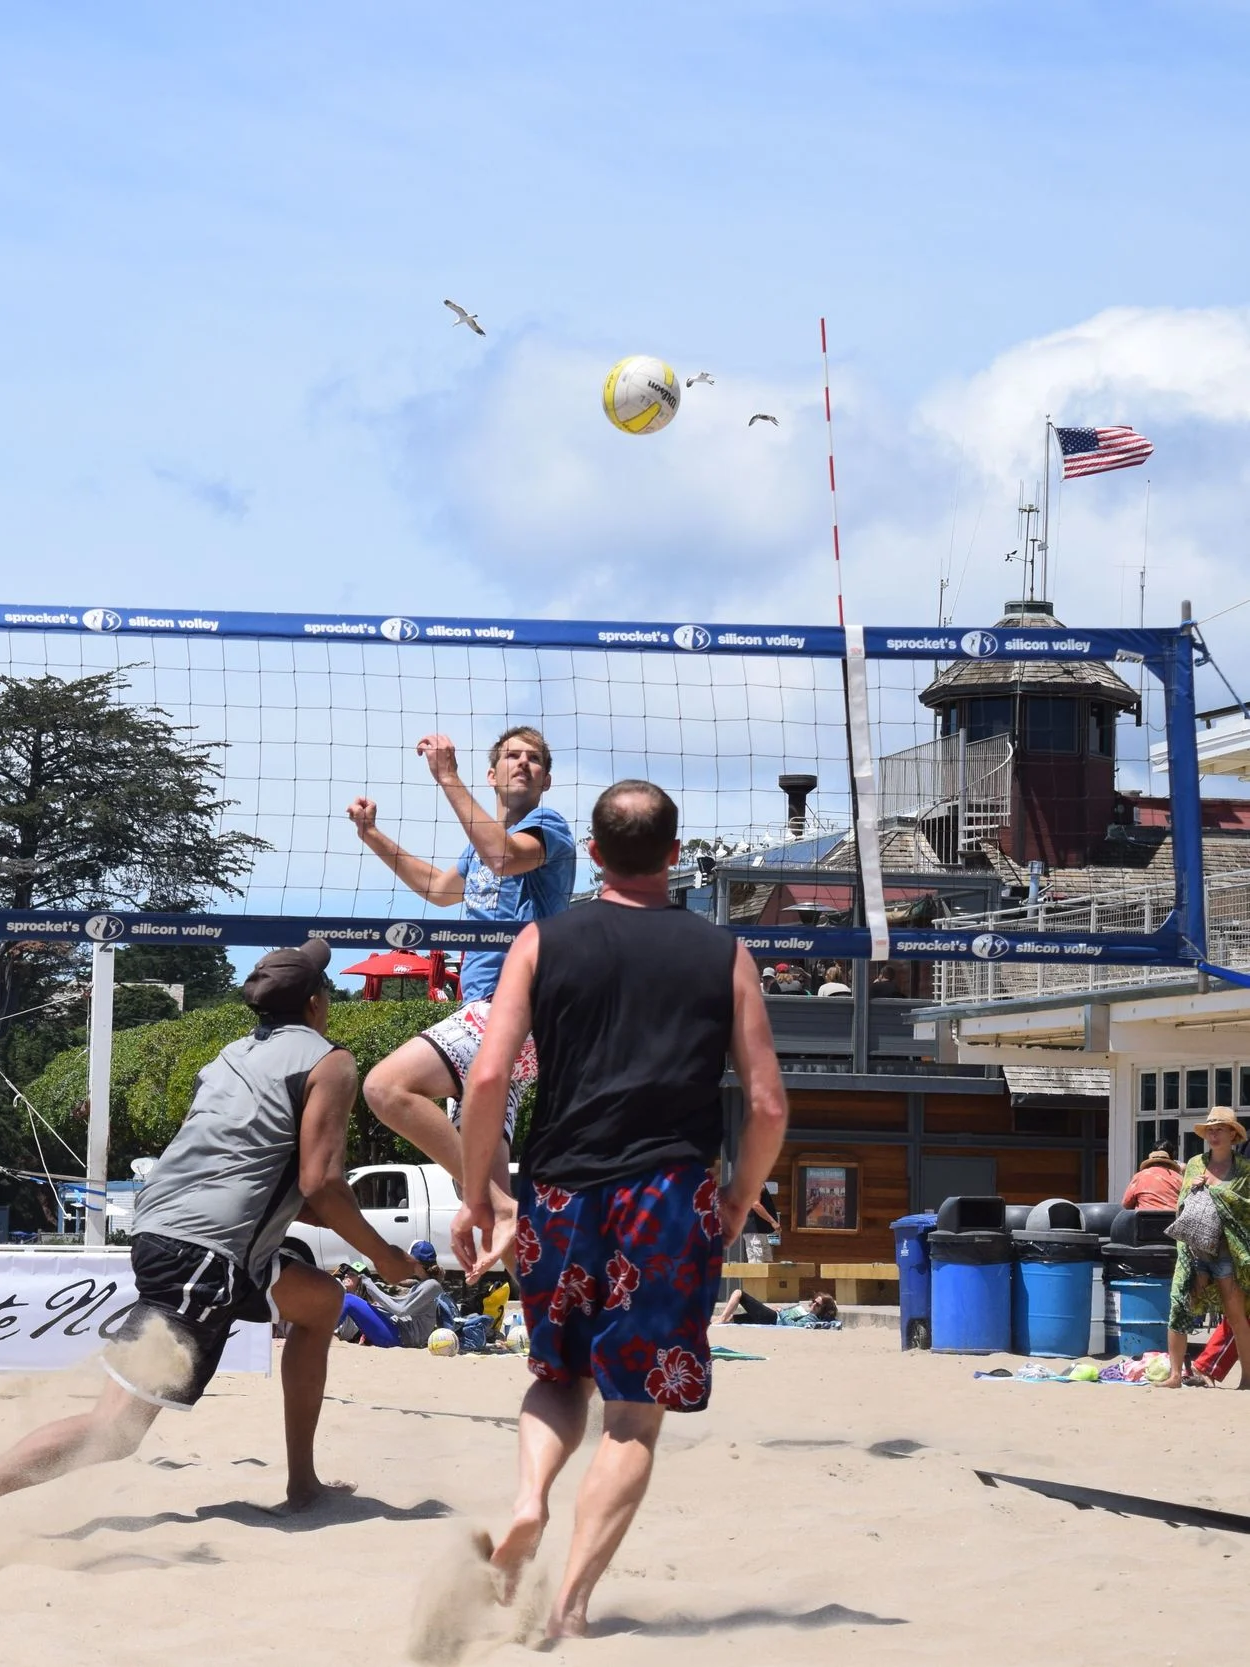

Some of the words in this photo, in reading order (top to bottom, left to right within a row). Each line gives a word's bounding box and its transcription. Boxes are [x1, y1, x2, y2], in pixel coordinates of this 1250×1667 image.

[647, 380, 677, 410] Wilson
[5, 613, 78, 624] sprocket's
[129, 616, 174, 627] silicon
[178, 618, 218, 631] volley
[304, 623, 376, 634] sprocket's
[426, 625, 469, 636] silicon
[473, 627, 514, 640] volley
[598, 631, 669, 642] sprocket's
[718, 633, 762, 645] silicon
[765, 635, 805, 648] volley
[887, 638, 957, 650] sprocket's
[1005, 639, 1048, 650] silicon
[1052, 639, 1090, 653] volley
[7, 921, 79, 932] sprocket's
[131, 923, 177, 934] silicon
[182, 925, 222, 938] volley
[308, 928, 380, 940] sprocket's
[431, 931, 475, 942] silicon
[774, 938, 813, 950] volley
[897, 940, 967, 951] sprocket's
[1016, 942, 1057, 953] silicon
[1063, 943, 1102, 956] volley
